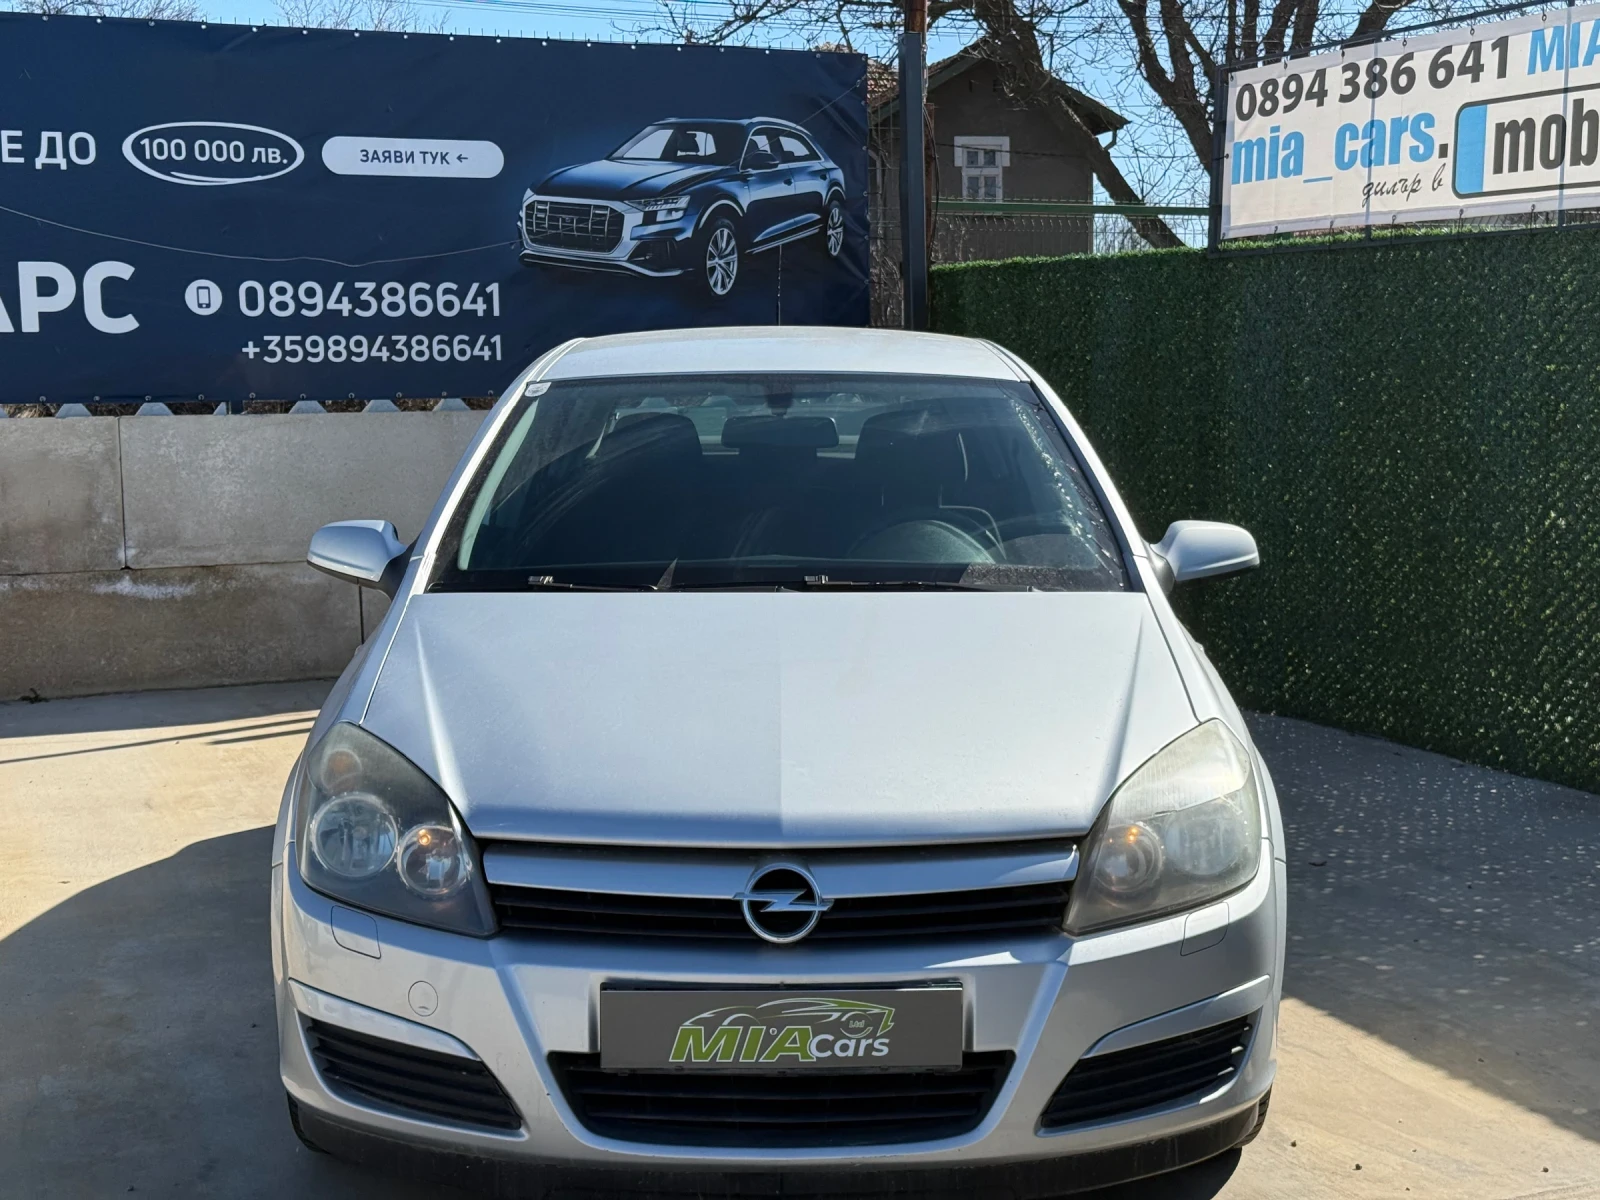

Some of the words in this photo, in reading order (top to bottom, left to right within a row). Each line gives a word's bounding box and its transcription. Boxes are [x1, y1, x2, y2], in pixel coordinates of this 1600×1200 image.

[1235, 69, 1329, 122] 0894
[1338, 52, 1416, 103] 386
[1428, 36, 1510, 89] 641
[35, 131, 96, 170] ДО
[140, 138, 187, 161] 100
[195, 140, 245, 163] 000
[252, 146, 289, 165] лв.
[359, 149, 416, 164] ЗАЯВИ
[420, 151, 450, 165] ТУК
[0, 260, 140, 334] РС
[238, 280, 501, 317] 0894386641
[241, 334, 502, 363] +359894386641
